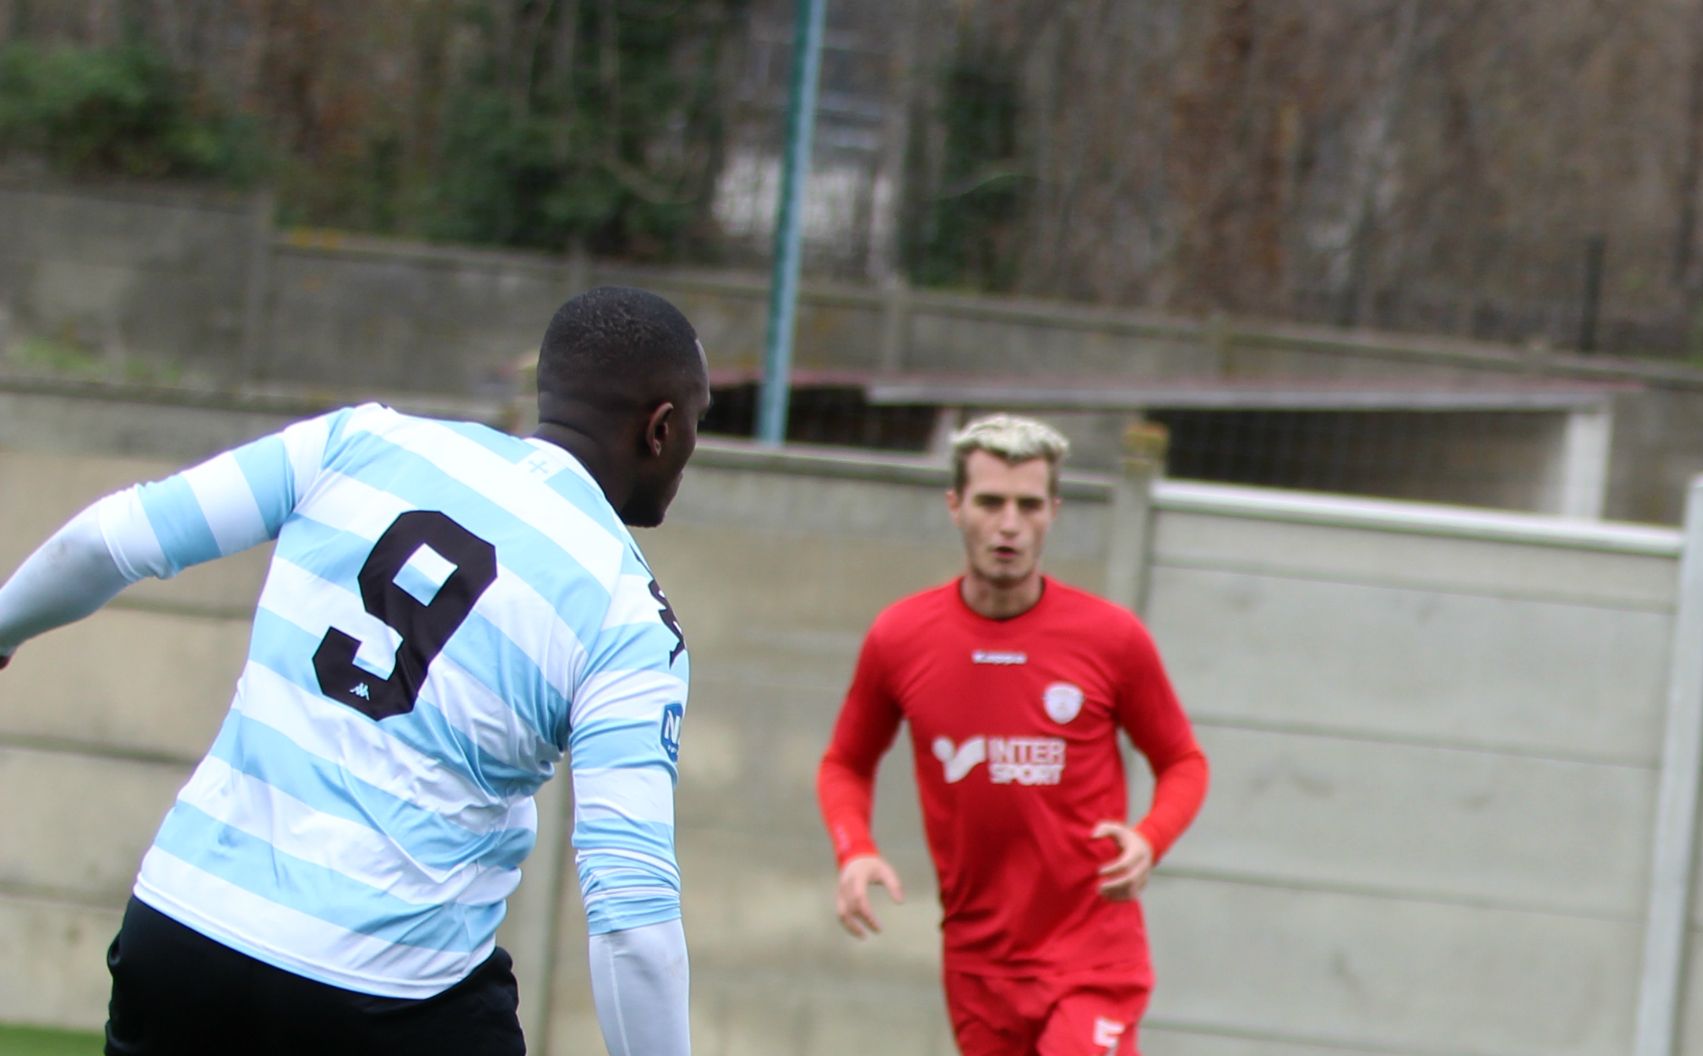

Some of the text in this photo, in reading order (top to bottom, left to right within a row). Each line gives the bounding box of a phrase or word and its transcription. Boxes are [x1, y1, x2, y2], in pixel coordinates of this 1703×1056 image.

[312, 510, 498, 722] 9
[988, 737, 1066, 764] INTER
[989, 764, 1065, 786] SPORT
